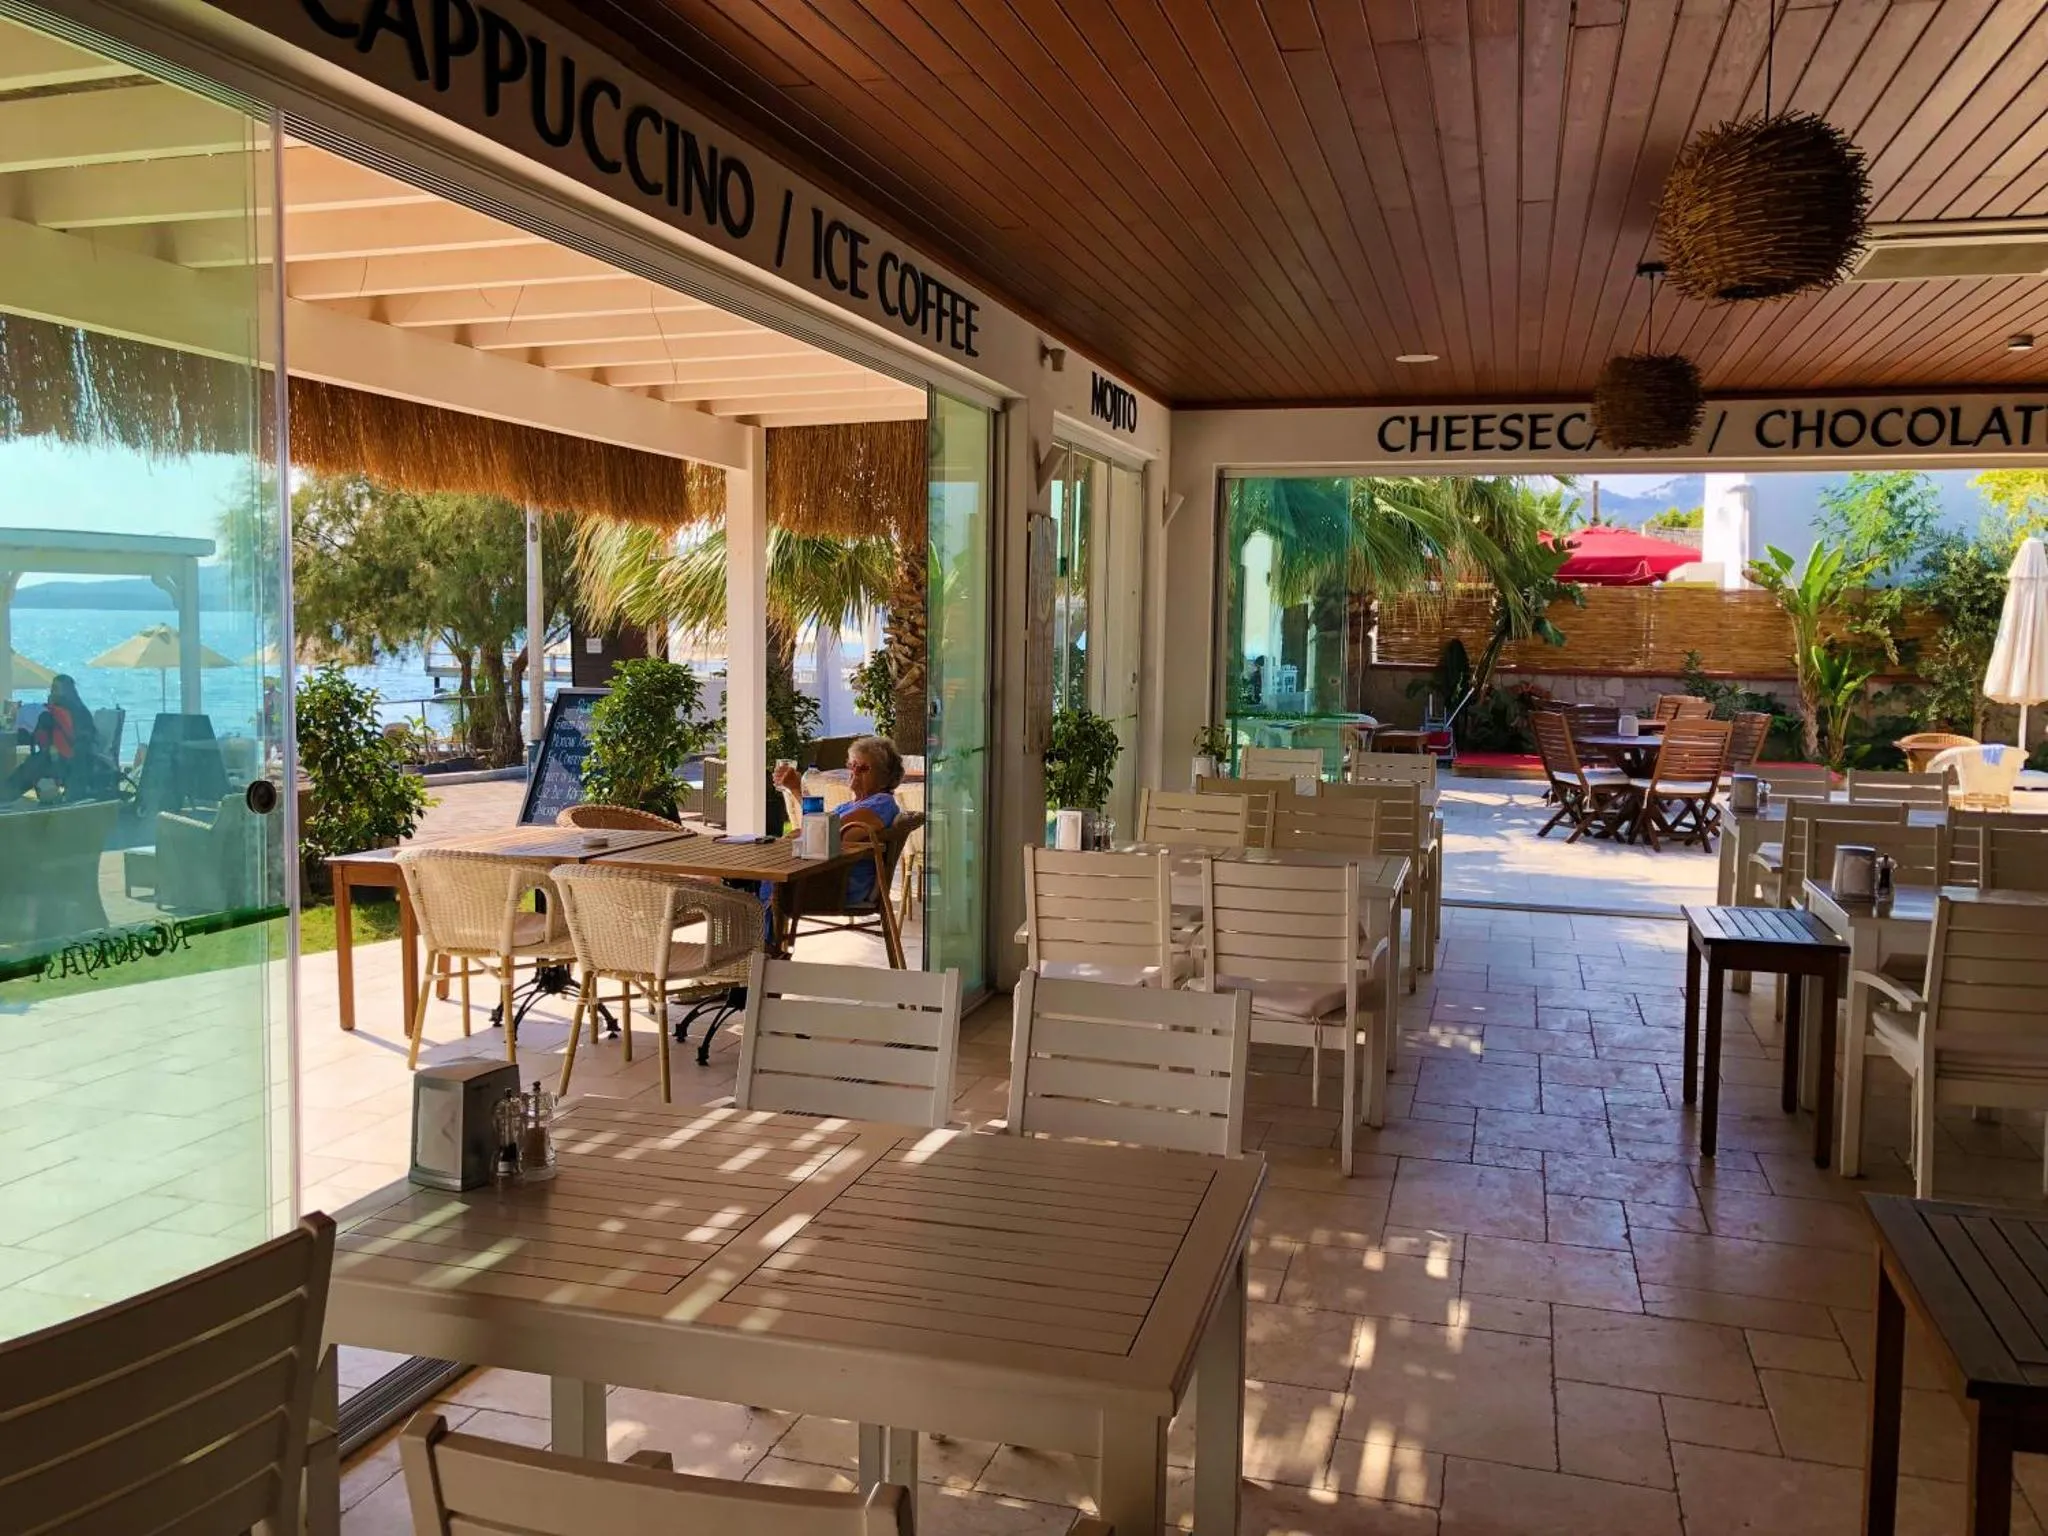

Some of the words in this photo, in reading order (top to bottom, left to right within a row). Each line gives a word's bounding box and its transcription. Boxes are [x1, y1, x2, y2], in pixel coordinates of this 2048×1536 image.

[775, 189, 794, 268] /
[811, 207, 871, 299] ICE
[877, 251, 980, 357] COFFEE
[1091, 371, 1137, 433] MOJITO
[1377, 413, 1600, 453] CHEESEC
[1707, 410, 1728, 453] /
[1755, 405, 2048, 449] CHOCOLAT
